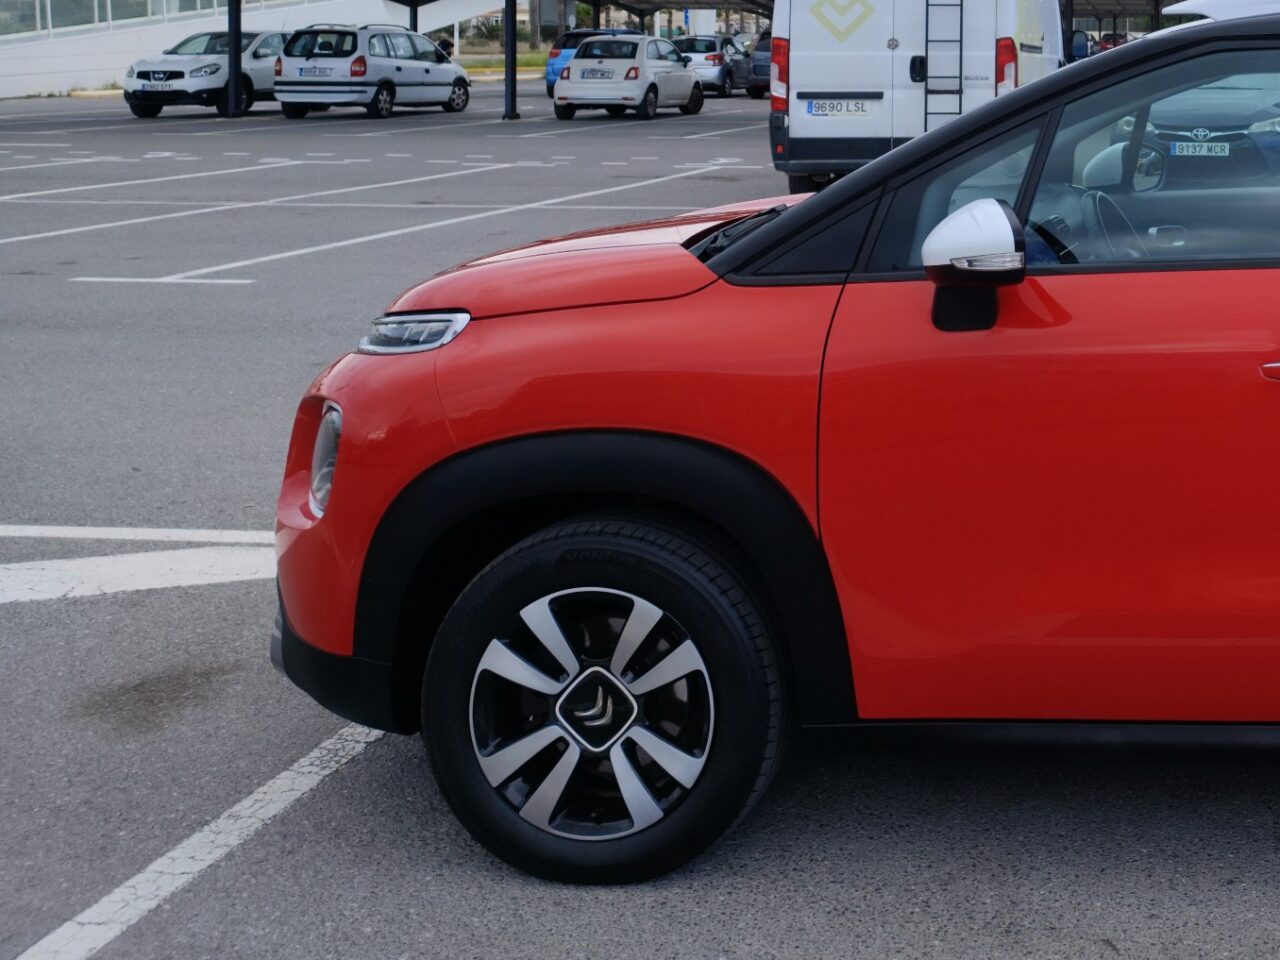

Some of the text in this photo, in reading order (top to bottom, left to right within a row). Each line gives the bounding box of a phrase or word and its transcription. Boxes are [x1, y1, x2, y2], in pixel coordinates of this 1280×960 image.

[813, 102, 868, 113] 9690 LSL
[1177, 143, 1227, 154] 9137 MCR
